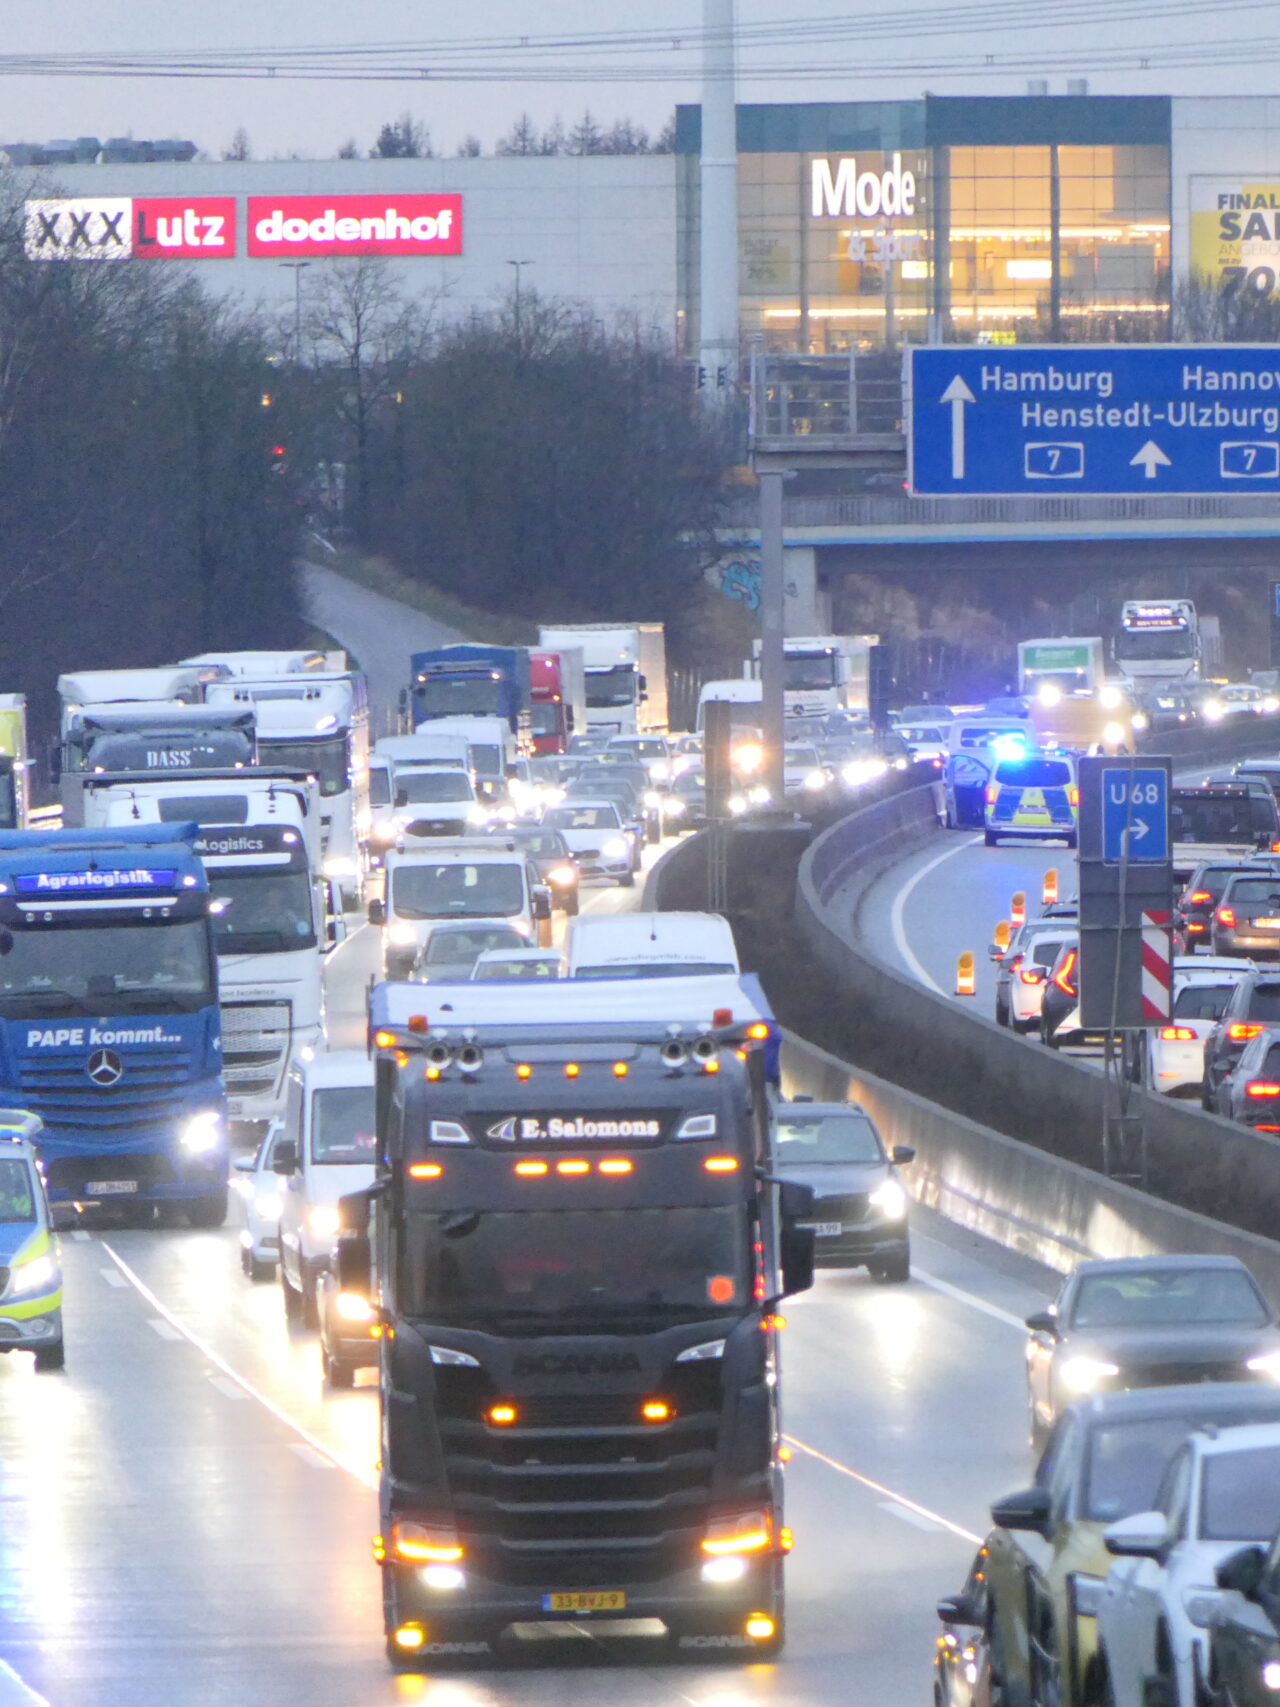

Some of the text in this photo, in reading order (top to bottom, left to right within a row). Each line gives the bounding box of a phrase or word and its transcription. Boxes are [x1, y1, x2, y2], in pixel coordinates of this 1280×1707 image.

[812, 153, 916, 217] Mode
[1218, 193, 1280, 210] FINAL
[255, 208, 454, 243] dodenhof
[981, 366, 1113, 397] Hamburg
[1022, 402, 1279, 433] Henstedt-Ulzburg
[1048, 450, 1060, 470] 7
[1244, 450, 1256, 470] 7
[37, 869, 154, 890] Agrarlogistik
[27, 1026, 182, 1048] PAPE kommt...
